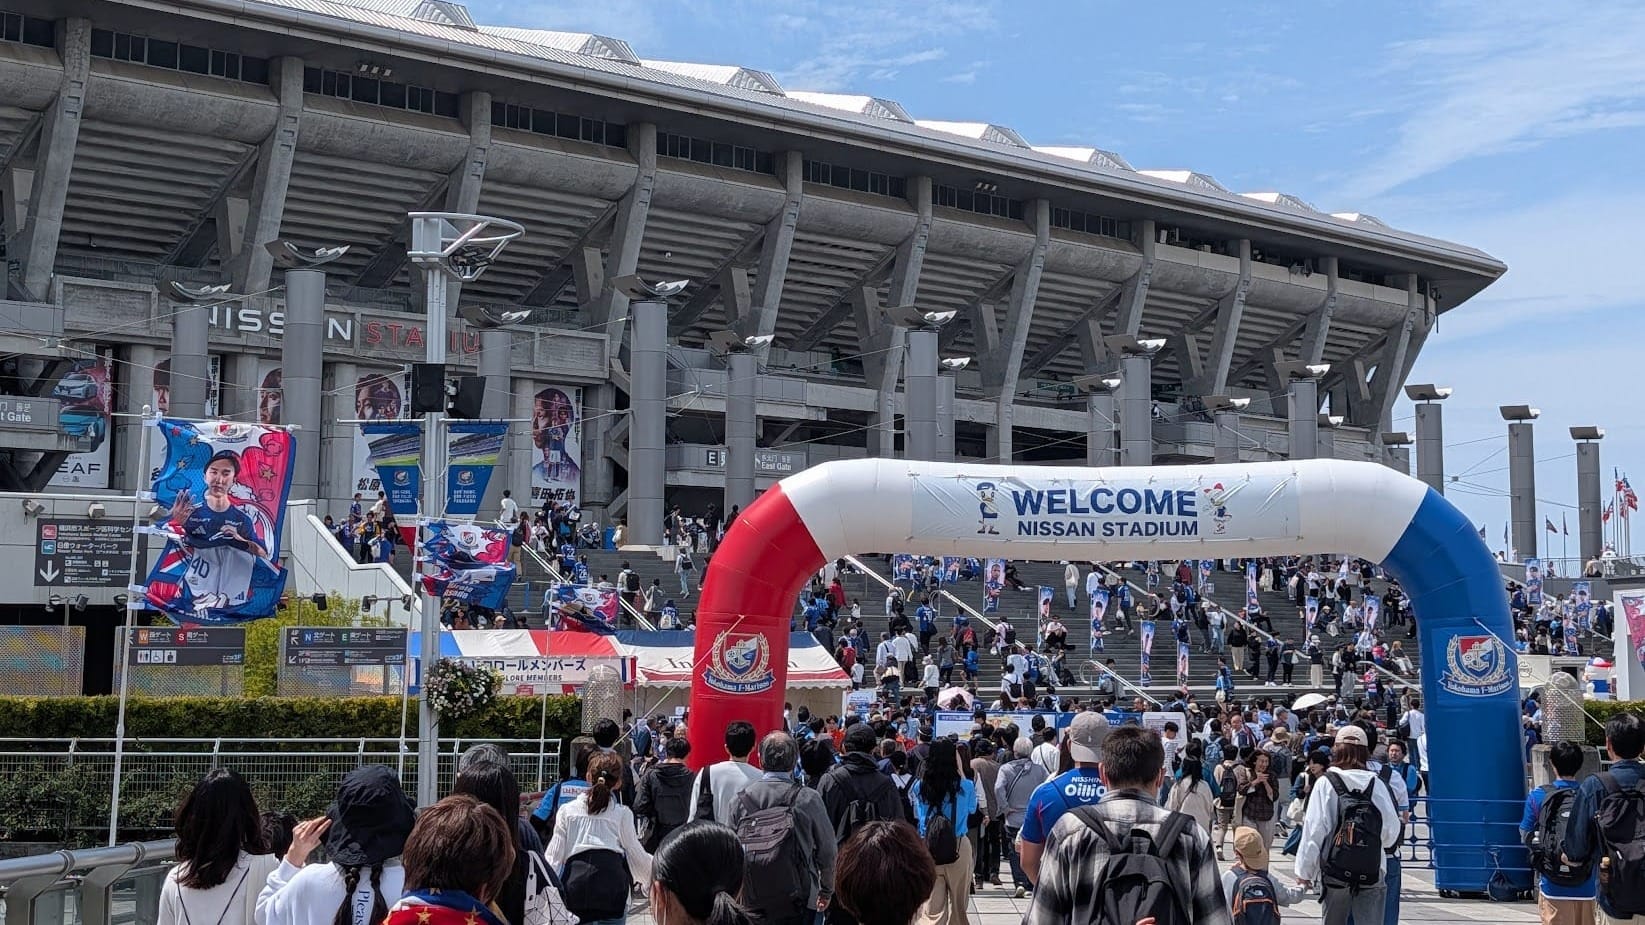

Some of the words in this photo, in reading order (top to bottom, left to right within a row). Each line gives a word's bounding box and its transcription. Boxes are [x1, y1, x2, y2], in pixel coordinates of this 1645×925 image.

[8, 412, 32, 423] Gate
[708, 451, 717, 464] E
[761, 461, 776, 470] East
[776, 463, 792, 471] Gate
[1012, 488, 1198, 517] WELCOME
[1017, 520, 1095, 536] NISSAN
[1102, 521, 1198, 536] STADIUM
[178, 633, 185, 641] S
[1447, 680, 1480, 693] Yokohama
